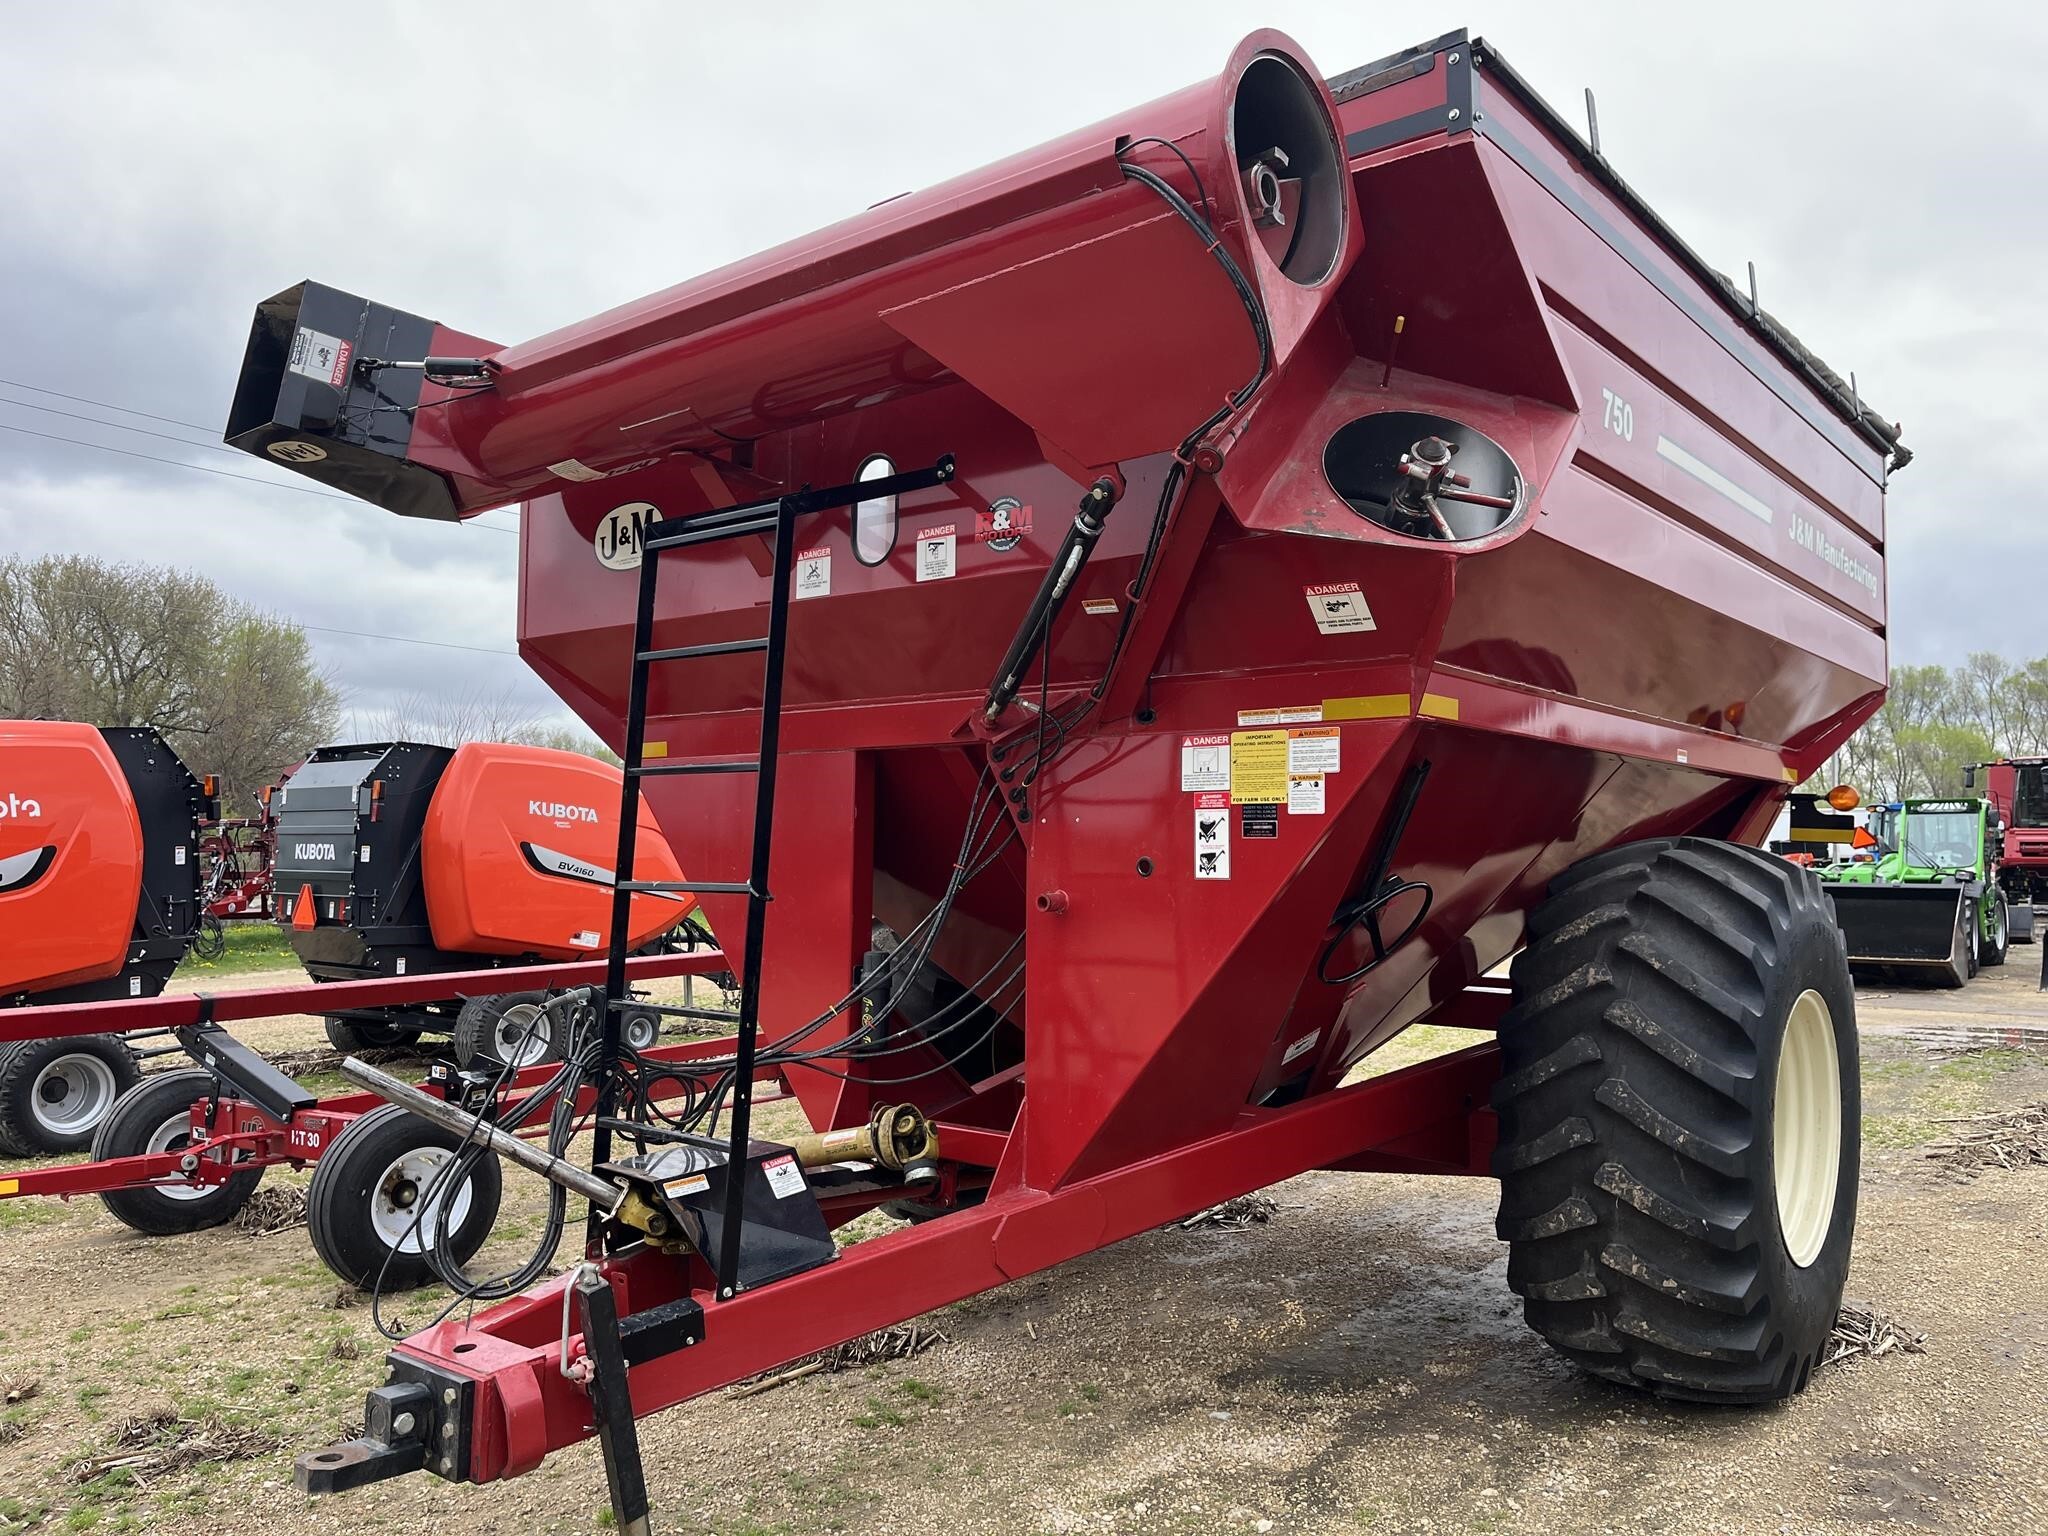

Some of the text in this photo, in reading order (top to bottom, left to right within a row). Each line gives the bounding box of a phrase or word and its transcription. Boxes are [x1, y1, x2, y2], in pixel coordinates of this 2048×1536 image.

[332, 350, 349, 385] DANGER
[1602, 387, 1633, 442] 750
[975, 505, 1033, 532] R&M
[599, 508, 655, 561] J&M
[924, 524, 956, 538] DANGER
[974, 525, 1034, 544] MOTORS
[803, 547, 831, 560] DANGER
[1788, 513, 1878, 599] J&M Manufacturing
[1314, 582, 1360, 595] DANGER
[1193, 735, 1229, 746] DANGER
[529, 800, 598, 824] KUBOTA
[295, 843, 336, 861] KUBOTA
[558, 861, 595, 877] BV4160
[307, 1132, 320, 1148] 30
